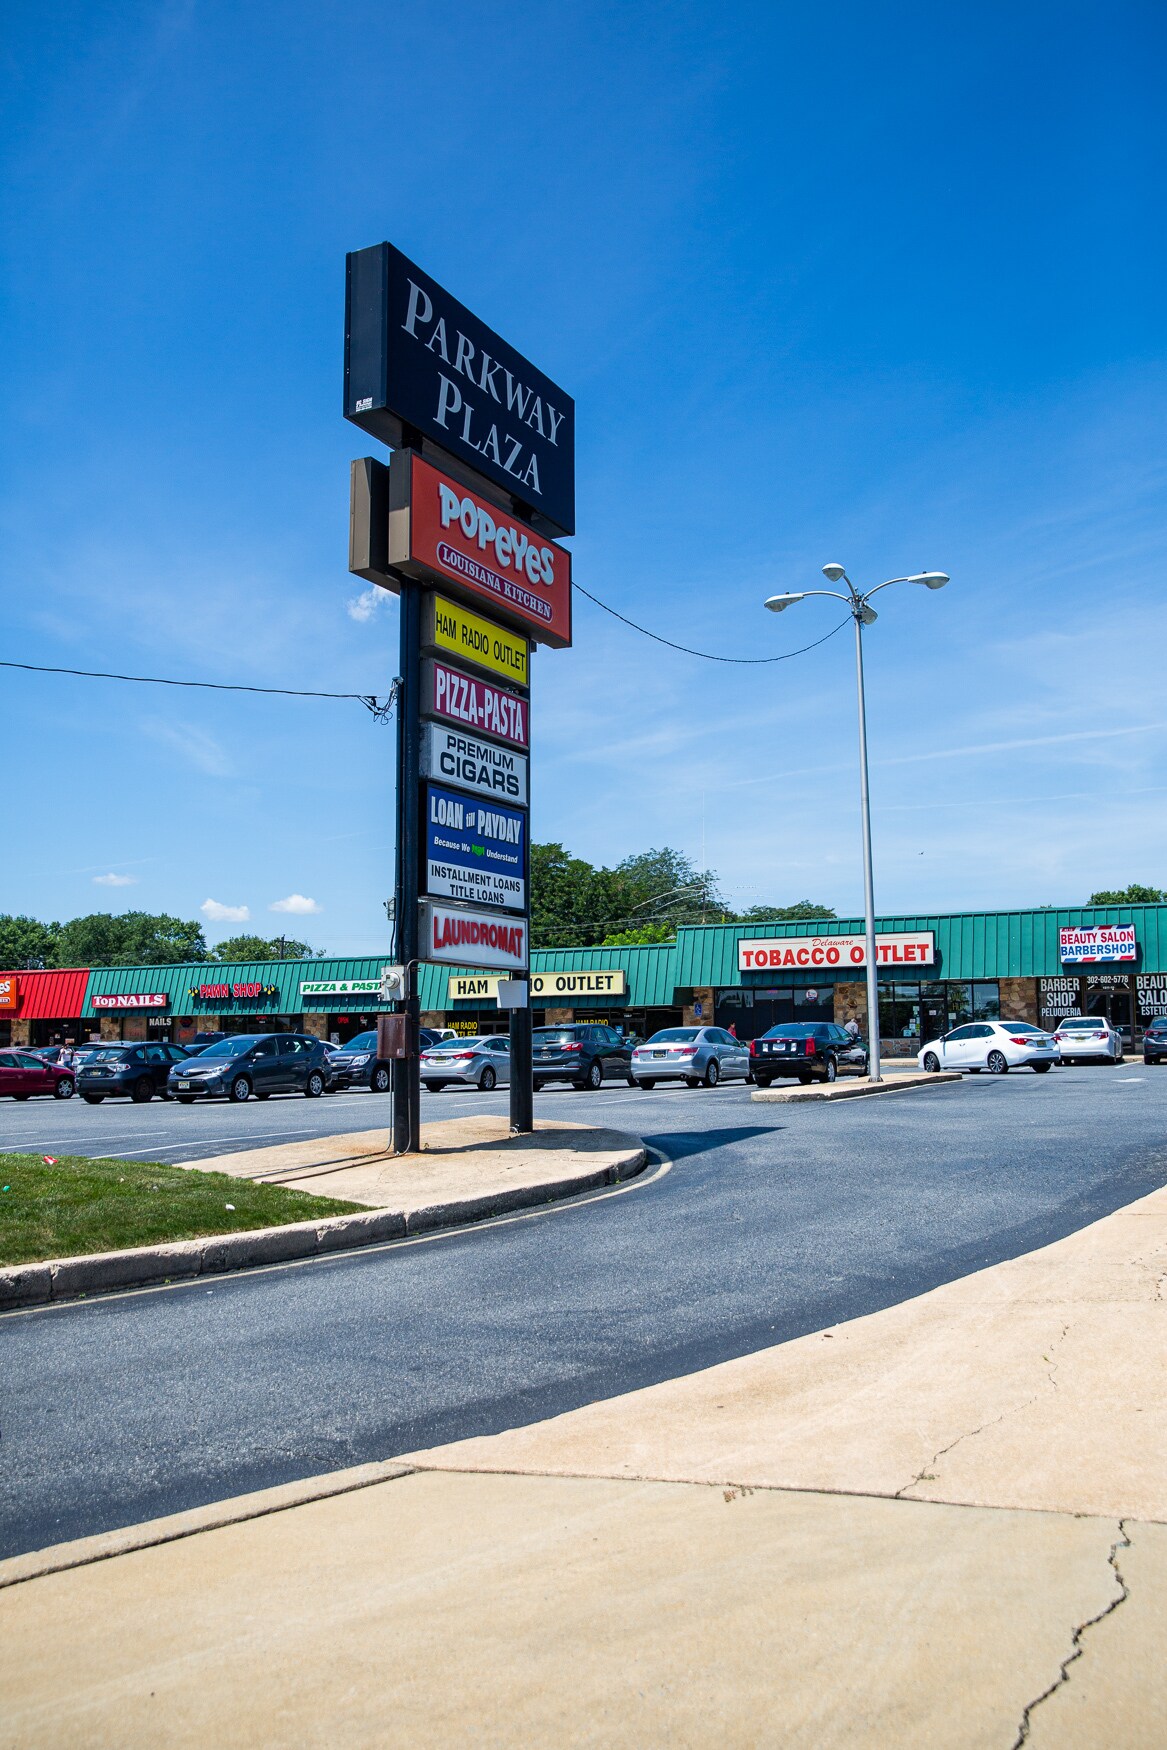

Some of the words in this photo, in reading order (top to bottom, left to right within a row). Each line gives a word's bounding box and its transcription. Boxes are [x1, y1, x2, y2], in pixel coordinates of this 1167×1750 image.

[401, 278, 565, 446] PARKWAY
[433, 372, 542, 495] PLAZA
[442, 547, 502, 592] LOUISIANA
[503, 581, 550, 618] KITCHEN
[435, 611, 456, 640] HAM
[461, 624, 489, 655] RADIO
[493, 641, 526, 672] OUTLET
[436, 668, 524, 742] PIZZA-PASTA
[447, 734, 513, 771] PREMIUM
[440, 752, 519, 796] CIGARS
[431, 796, 463, 830] LOAN
[477, 809, 521, 844] PAYDAY
[433, 836, 460, 850] Because
[461, 843, 470, 852] We
[486, 849, 518, 864] Understand
[431, 864, 491, 887] INSTALLMENT
[493, 877, 520, 892] LOANS
[450, 884, 474, 899] TITLE
[477, 889, 504, 904] LOANS
[433, 916, 523, 959] LAUNDROMAT
[811, 938, 854, 947] Delaware
[1061, 933, 1097, 944] BEAUTY
[1100, 931, 1134, 943] SALON
[742, 947, 840, 967] TOBACCO
[849, 944, 930, 964] OTLET
[1060, 943, 1135, 956] BARBERSHOP
[200, 984, 229, 998] PAWN
[232, 983, 262, 997] SHOP
[302, 984, 336, 992] PIZZA
[340, 983, 348, 991] &
[351, 982, 381, 991] PAST
[457, 980, 488, 994] HAM
[556, 975, 613, 991] OUTLET
[1040, 978, 1080, 991] BARBER
[94, 996, 116, 1007] Top
[117, 994, 164, 1006] NAILS
[1046, 992, 1076, 1006] SHOP
[1041, 1007, 1082, 1017] PELUQUERIA
[149, 1018, 172, 1026] NAILS
[447, 1021, 459, 1029] HAM
[460, 1021, 478, 1030] RADIO
